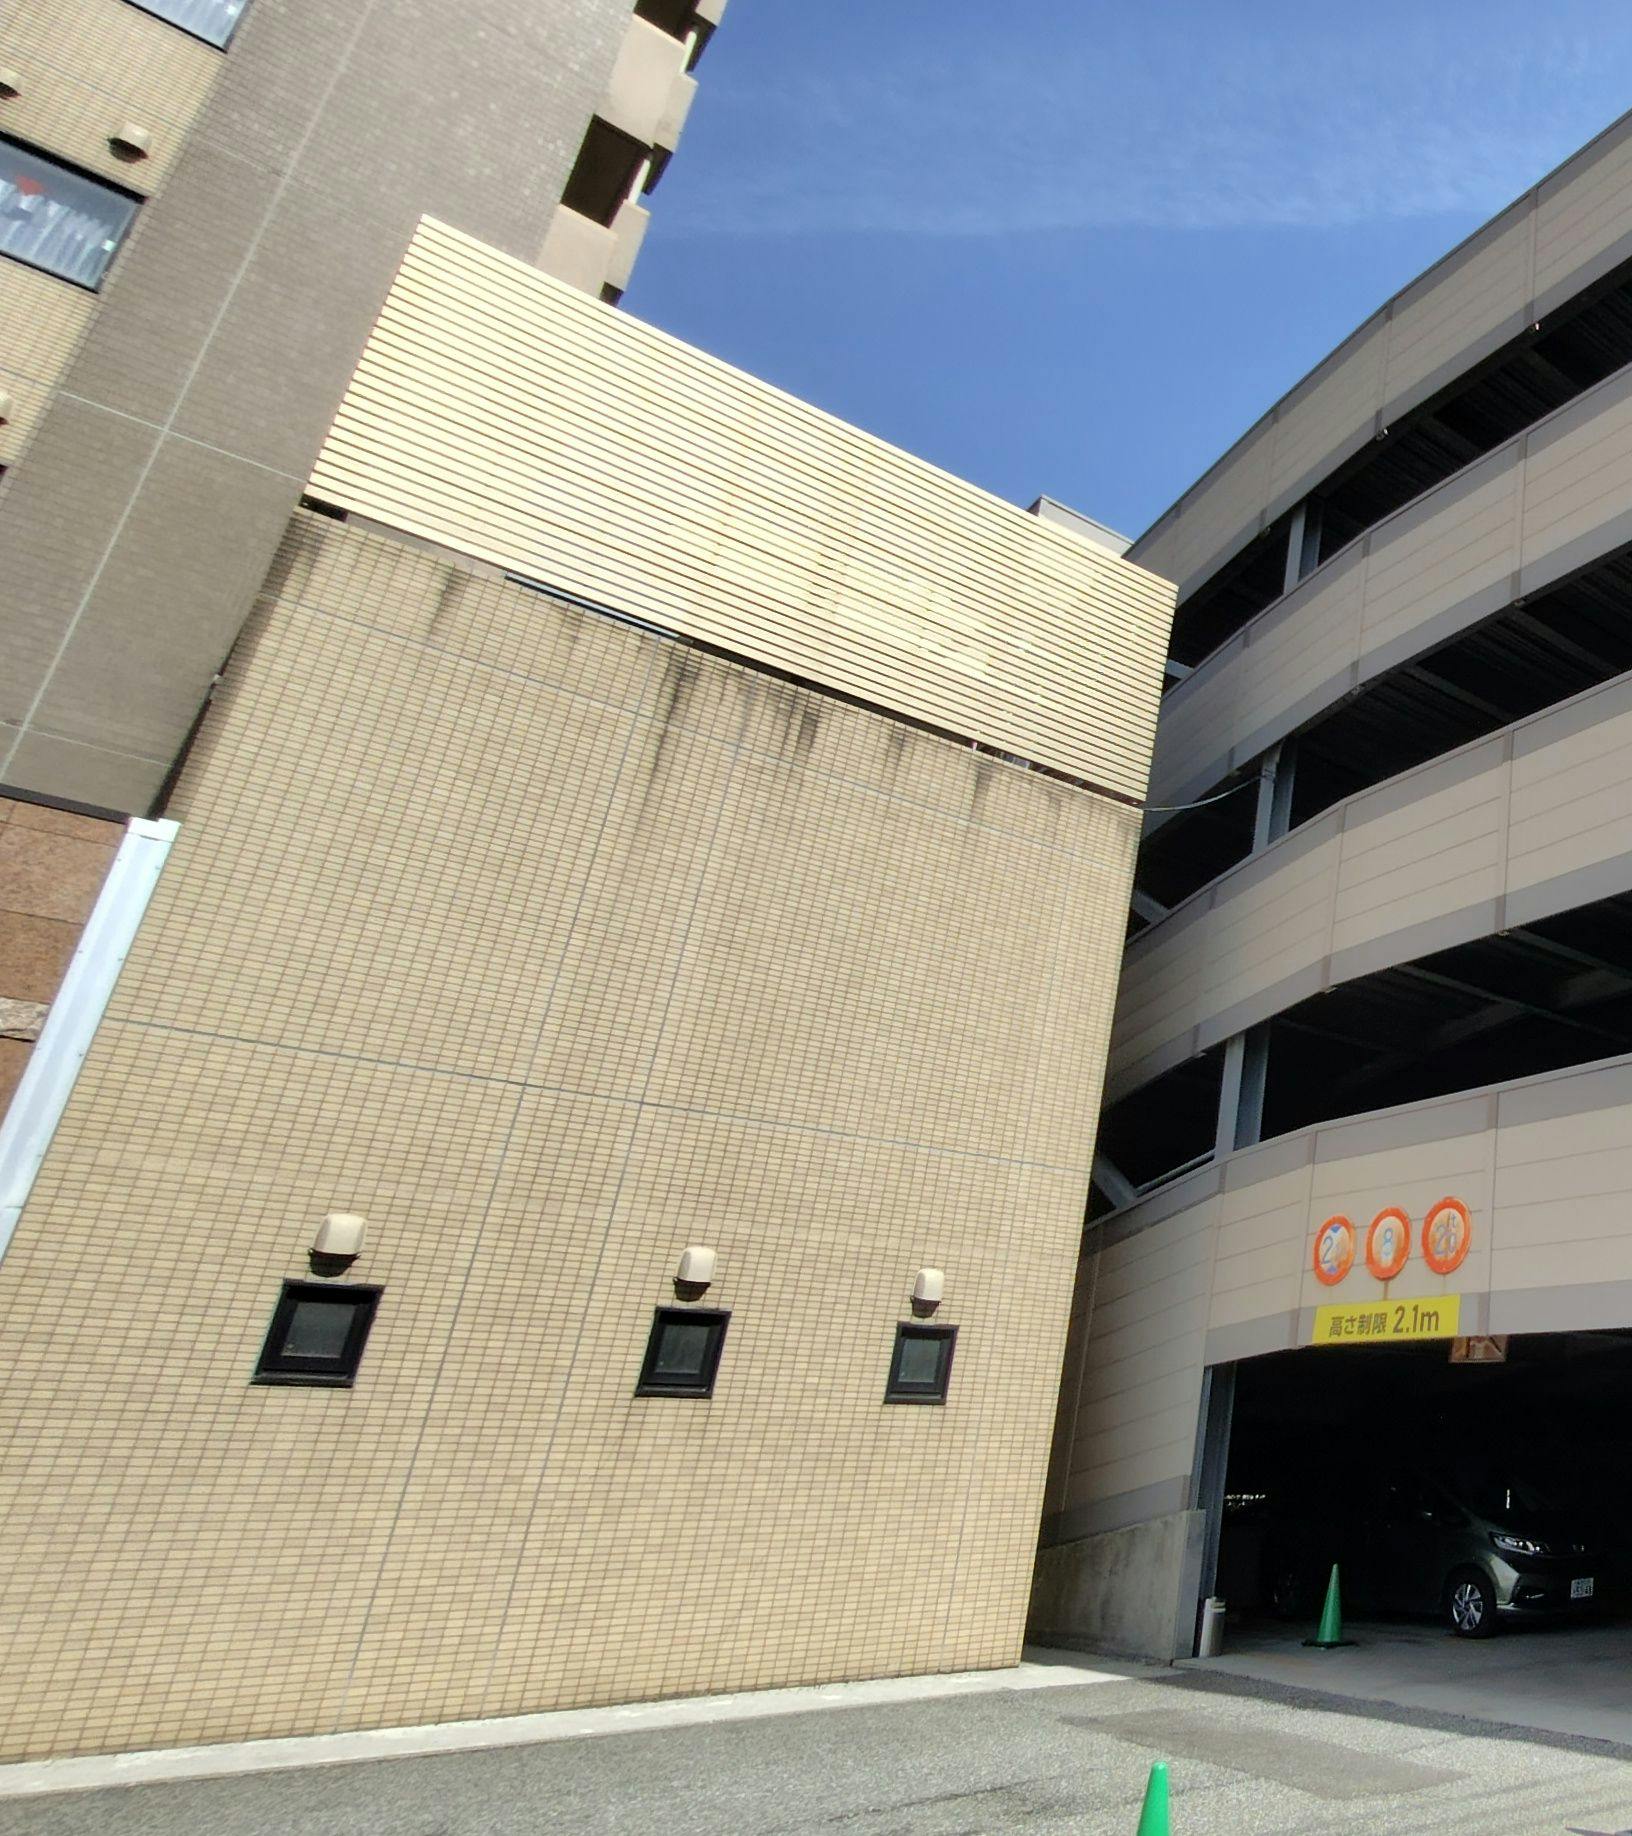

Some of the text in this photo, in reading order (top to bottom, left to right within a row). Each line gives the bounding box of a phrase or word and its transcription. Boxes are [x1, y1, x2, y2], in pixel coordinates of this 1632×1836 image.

[1329, 1304, 1440, 1337] 高さ制限 2.1m
